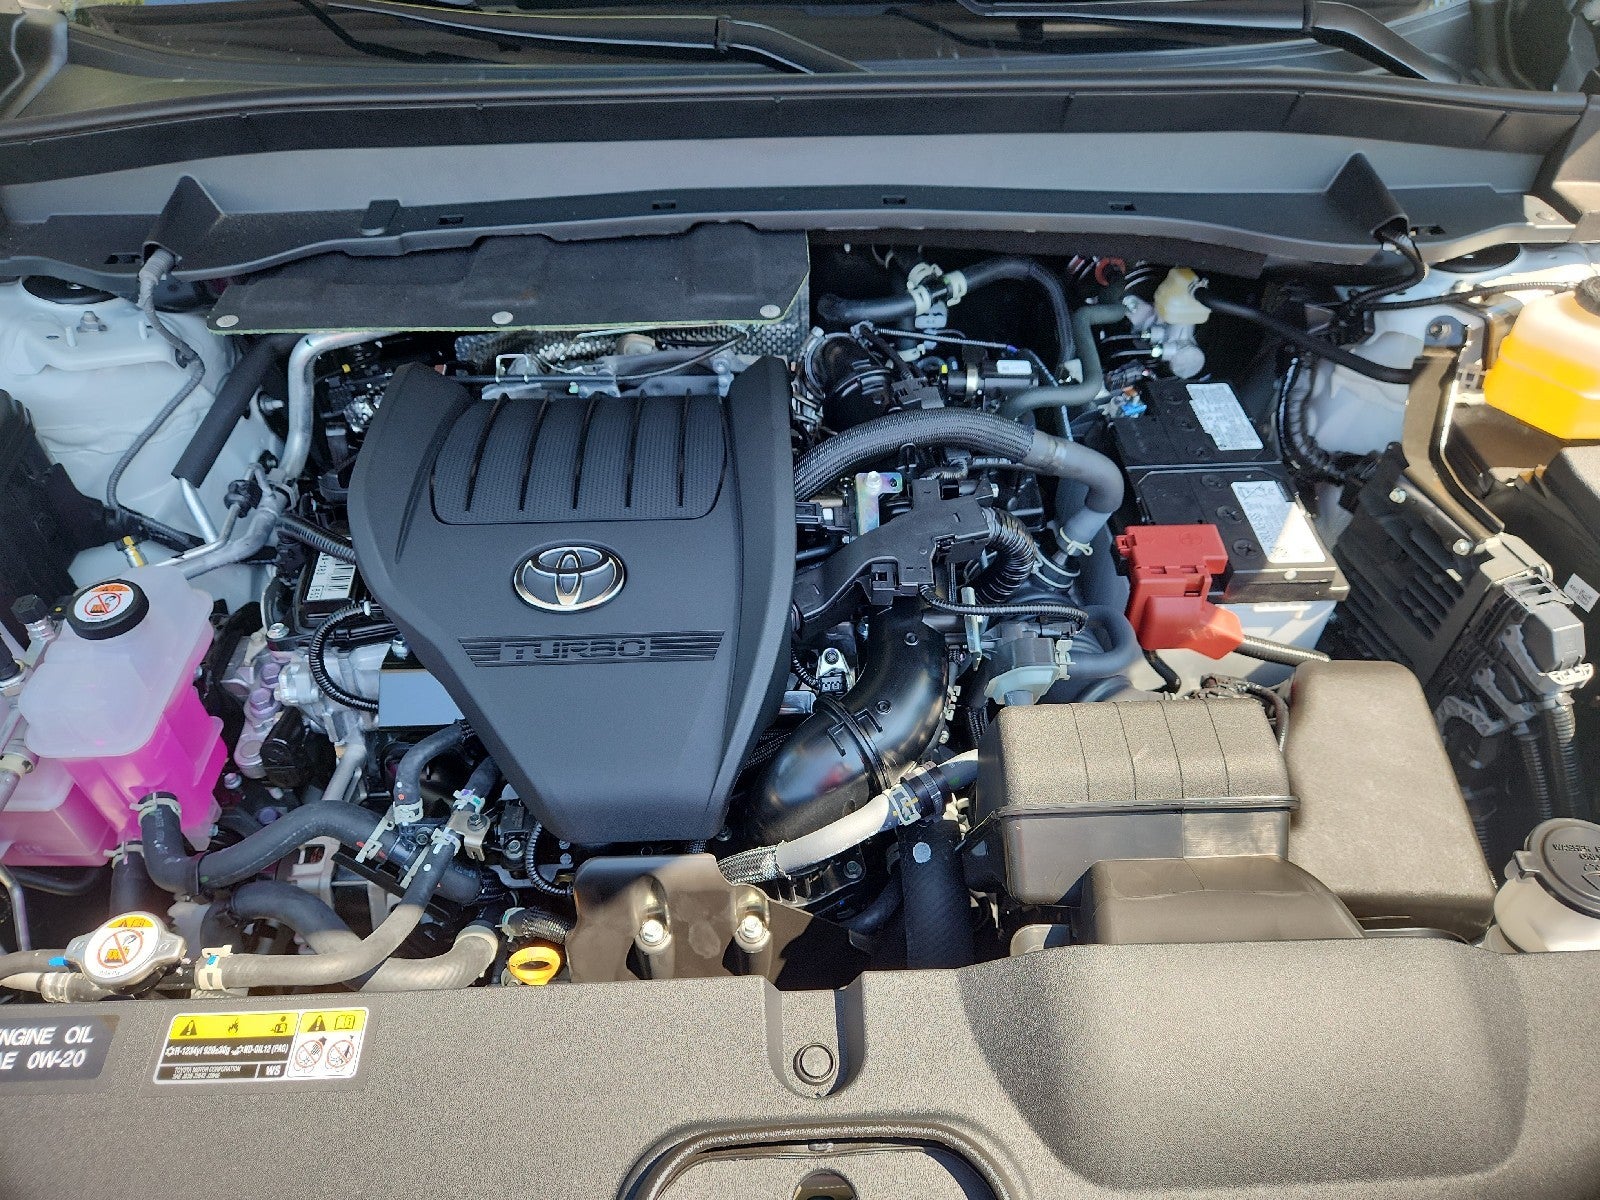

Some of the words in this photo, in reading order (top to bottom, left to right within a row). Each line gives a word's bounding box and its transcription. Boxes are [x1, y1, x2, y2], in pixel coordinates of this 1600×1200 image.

[504, 638, 647, 660] TURBO
[64, 1024, 95, 1045] OIL
[26, 1048, 87, 1070] 0W-20
